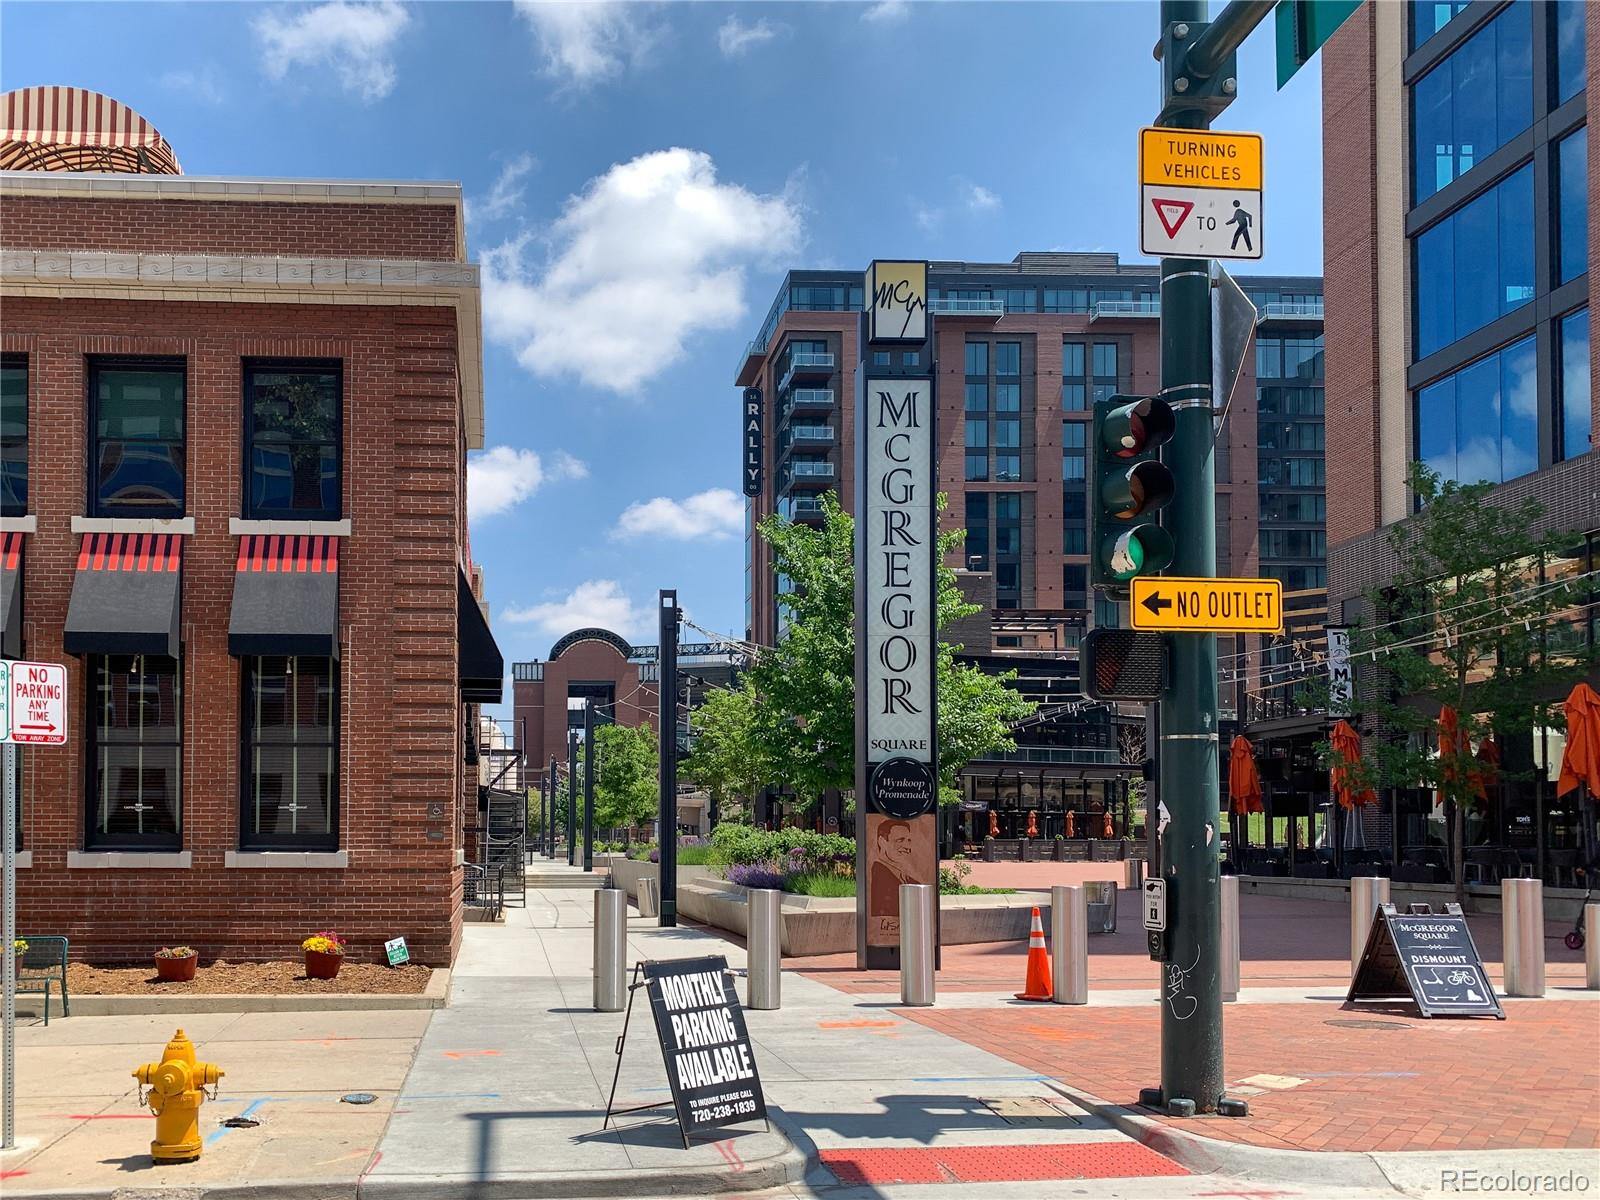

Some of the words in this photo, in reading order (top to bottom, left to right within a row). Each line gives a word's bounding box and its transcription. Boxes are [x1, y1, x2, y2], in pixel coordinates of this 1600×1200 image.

[1167, 140, 1237, 158] TURNING
[1163, 163, 1241, 181] VEHICLES
[1197, 216, 1217, 231] TO
[747, 403, 760, 481] RALLY
[1177, 591, 1200, 618] NO
[1208, 591, 1273, 619] OUTLET
[28, 667, 48, 683] NO
[16, 683, 61, 699] PARKING
[28, 699, 48, 710] ANY
[28, 711, 50, 722] TIME
[871, 738, 928, 751] SQUARE
[883, 777, 925, 791] Wynkoop
[878, 788, 930, 799] Promenade
[1400, 924, 1458, 933] McGREGOR
[1413, 932, 1450, 941] SQUARE
[1411, 955, 1467, 964] DISMOUNT
[658, 970, 728, 1011] MONTHLY
[670, 1007, 738, 1050] PARKING
[675, 1043, 754, 1091] AVAILABLE
[689, 1099, 698, 1108] TO
[698, 1095, 720, 1106] INQUIRE
[720, 1091, 740, 1102] PLEASE
[740, 1089, 754, 1098] CALL
[691, 1099, 757, 1123] 720-238-1839
